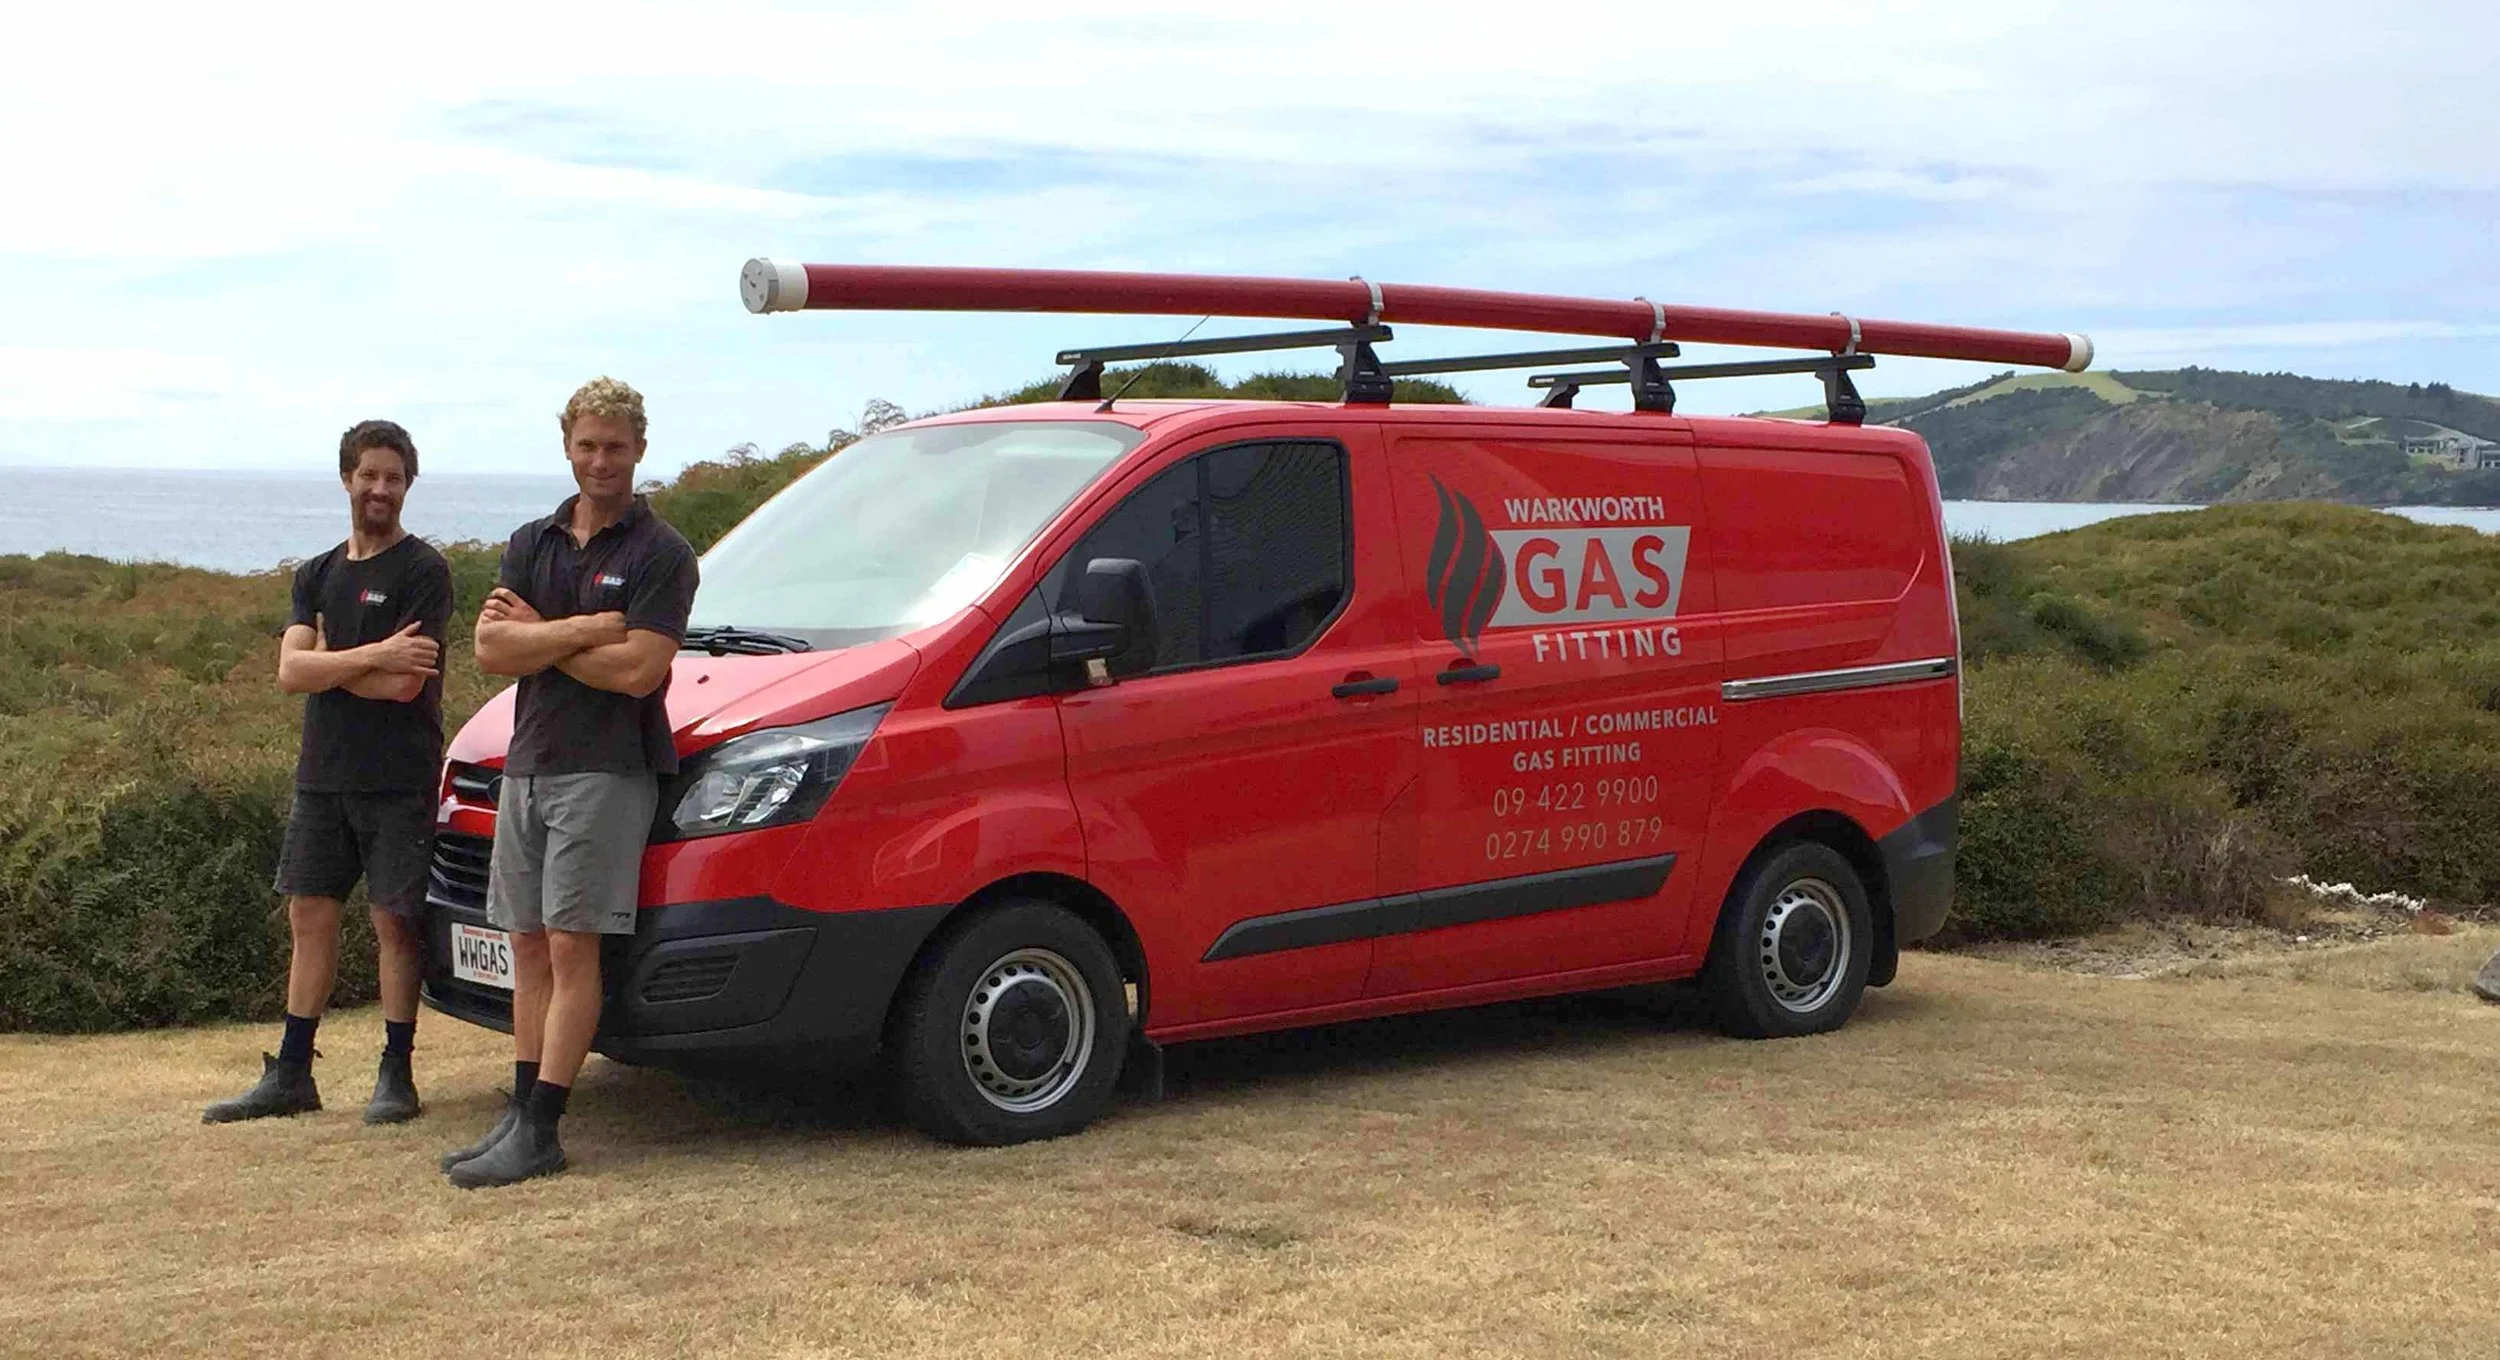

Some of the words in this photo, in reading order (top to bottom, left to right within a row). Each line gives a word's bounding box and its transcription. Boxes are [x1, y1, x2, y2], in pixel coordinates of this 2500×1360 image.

[1504, 496, 1665, 523] WARKWORTH
[1514, 534, 1671, 614] GAS
[1532, 626, 1682, 663] FITTING
[1423, 717, 1563, 748] RESIDENTIAL
[1585, 705, 1718, 735] COMMERCIAL
[1513, 750, 1554, 773] GAS
[1562, 742, 1641, 768] FITTING
[1493, 787, 1525, 817] 09
[1537, 782, 1585, 812] 422
[1596, 775, 1658, 807] 9900
[1485, 827, 1550, 861] 0274
[1561, 822, 1607, 852] 990
[1618, 816, 1662, 846] 879
[459, 935, 508, 976] WWGAS
